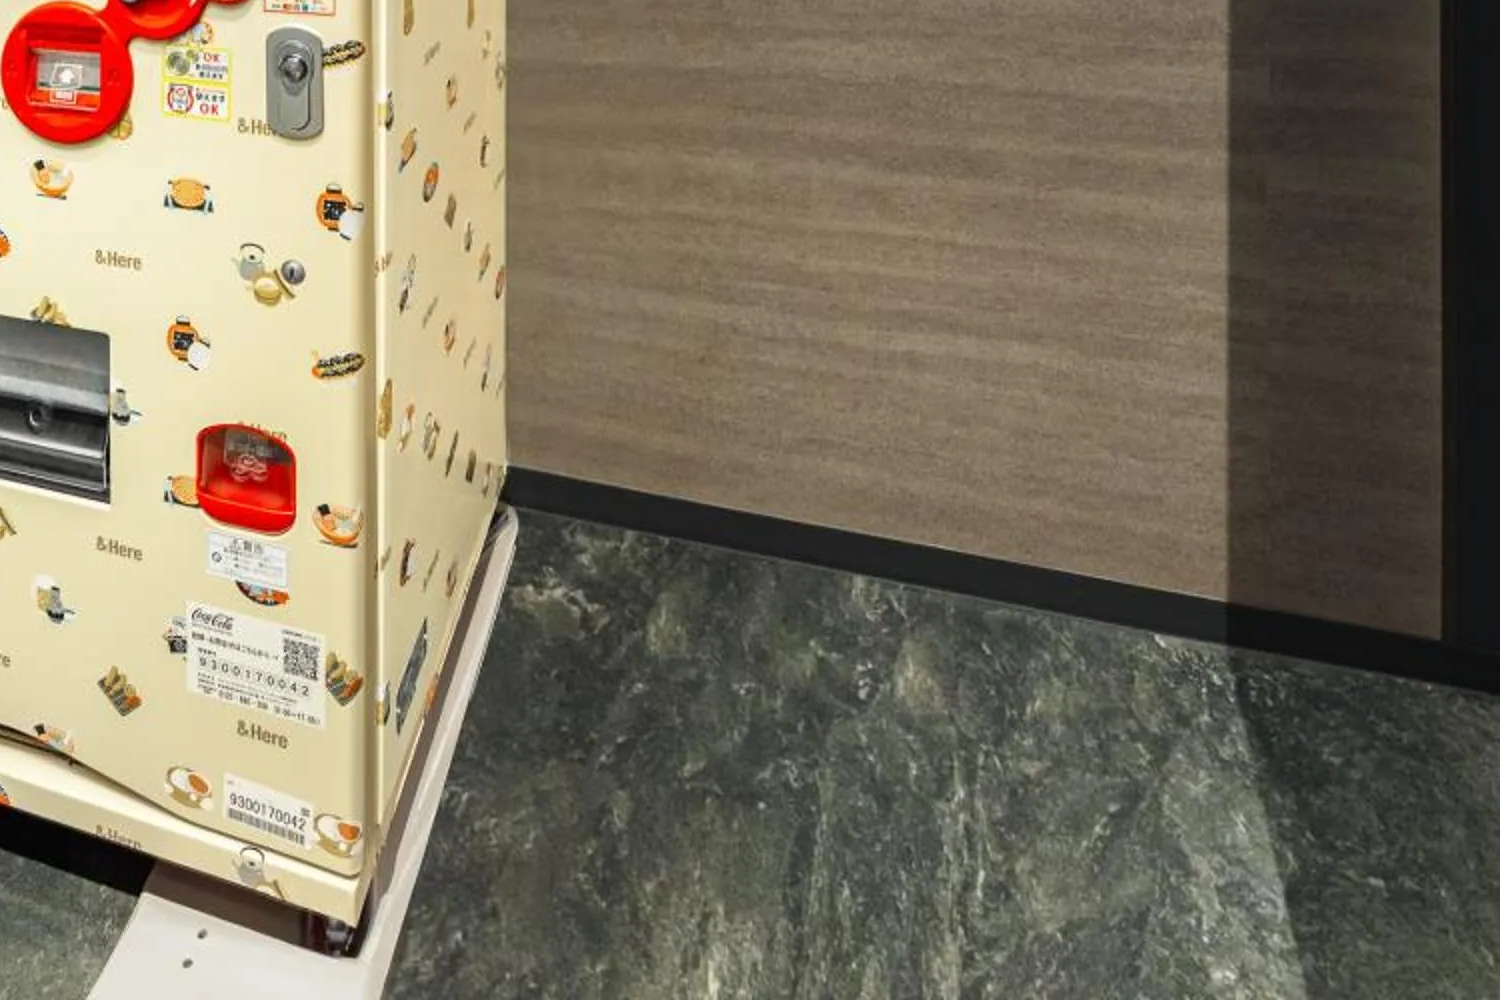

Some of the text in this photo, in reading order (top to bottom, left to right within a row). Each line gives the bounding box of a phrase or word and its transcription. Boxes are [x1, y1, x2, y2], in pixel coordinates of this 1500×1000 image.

[200, 103, 219, 116] OK
[95, 248, 142, 272] &Here
[95, 535, 144, 562] &Here
[236, 718, 289, 750] &Here
[228, 792, 308, 832] 9300170042
